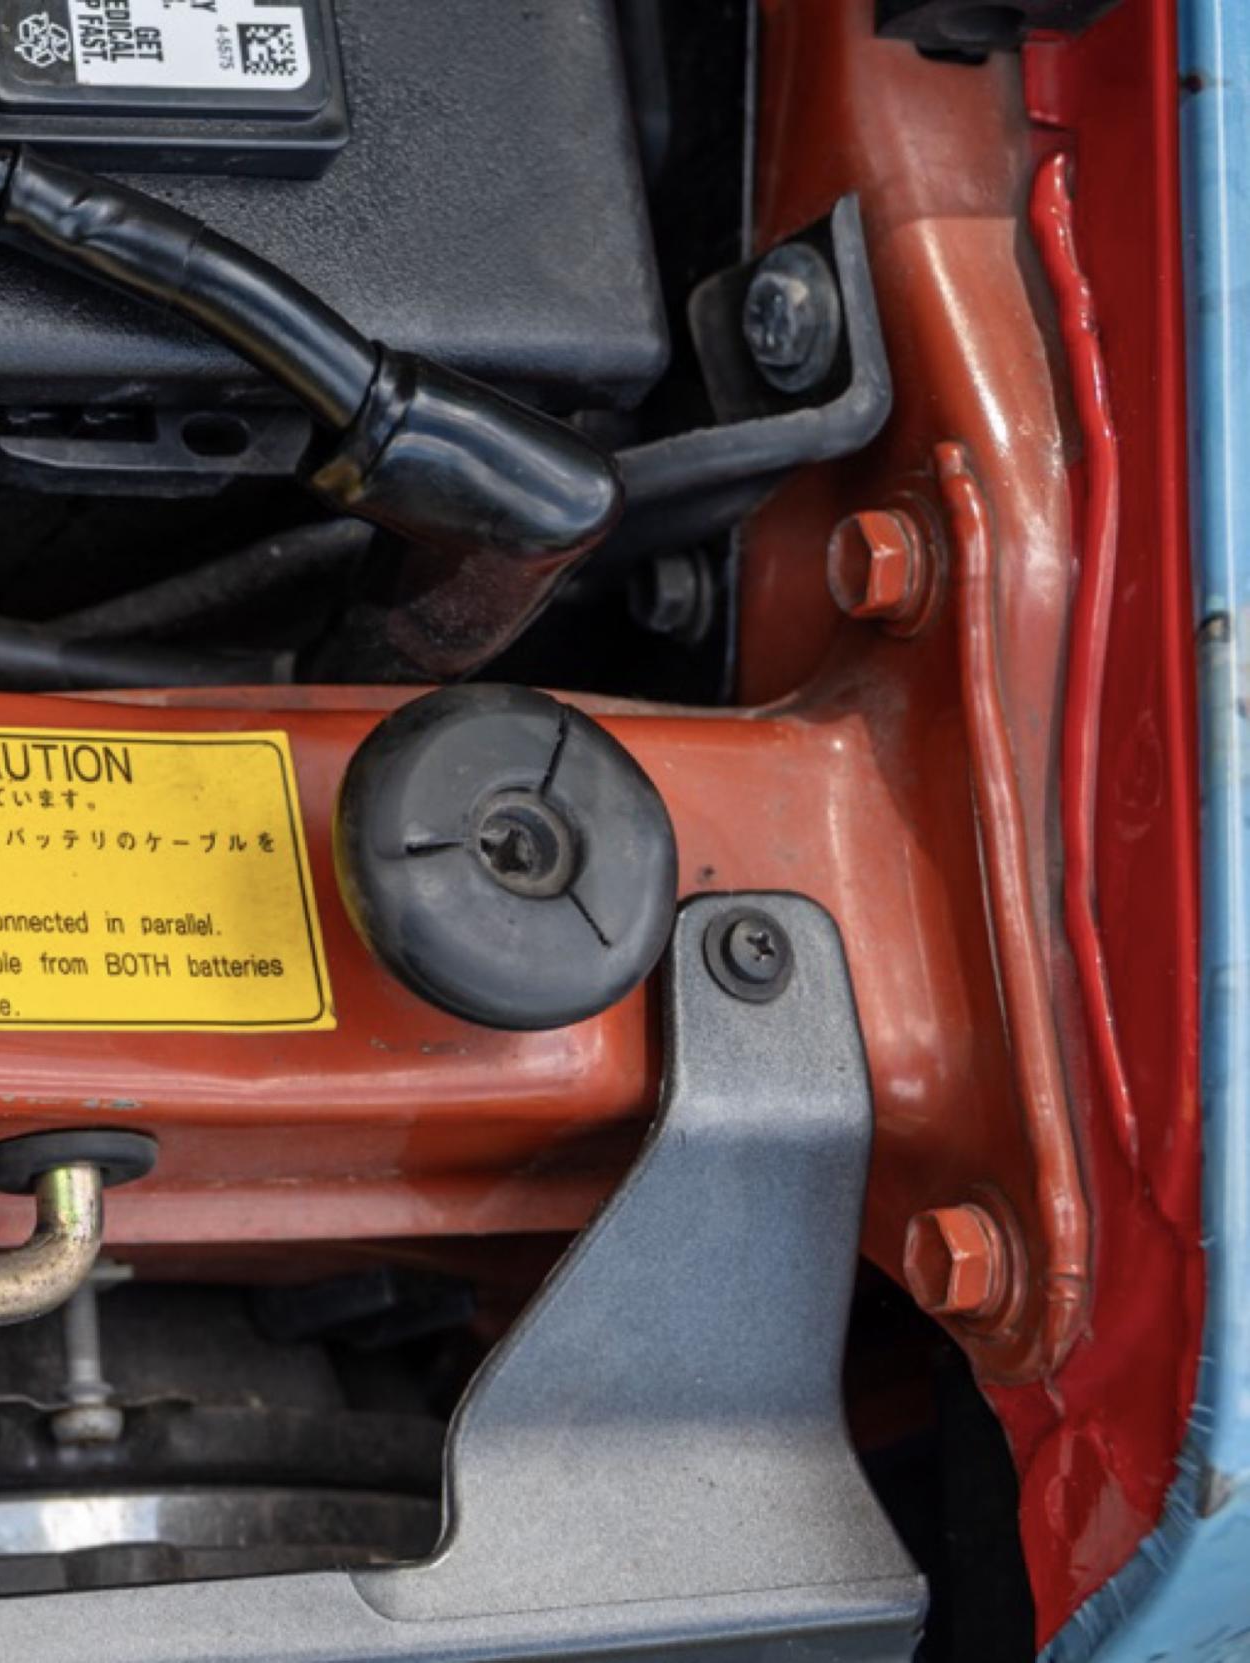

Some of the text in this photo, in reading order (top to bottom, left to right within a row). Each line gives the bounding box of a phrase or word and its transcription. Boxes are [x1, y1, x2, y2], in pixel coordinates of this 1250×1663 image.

[78, 14, 108, 64] FAST.
[134, 26, 163, 62] GET
[105, 911, 126, 934] in
[140, 912, 222, 937] parallel.
[39, 951, 89, 976] from
[104, 952, 171, 978] BOTH
[186, 954, 285, 979] batteries
